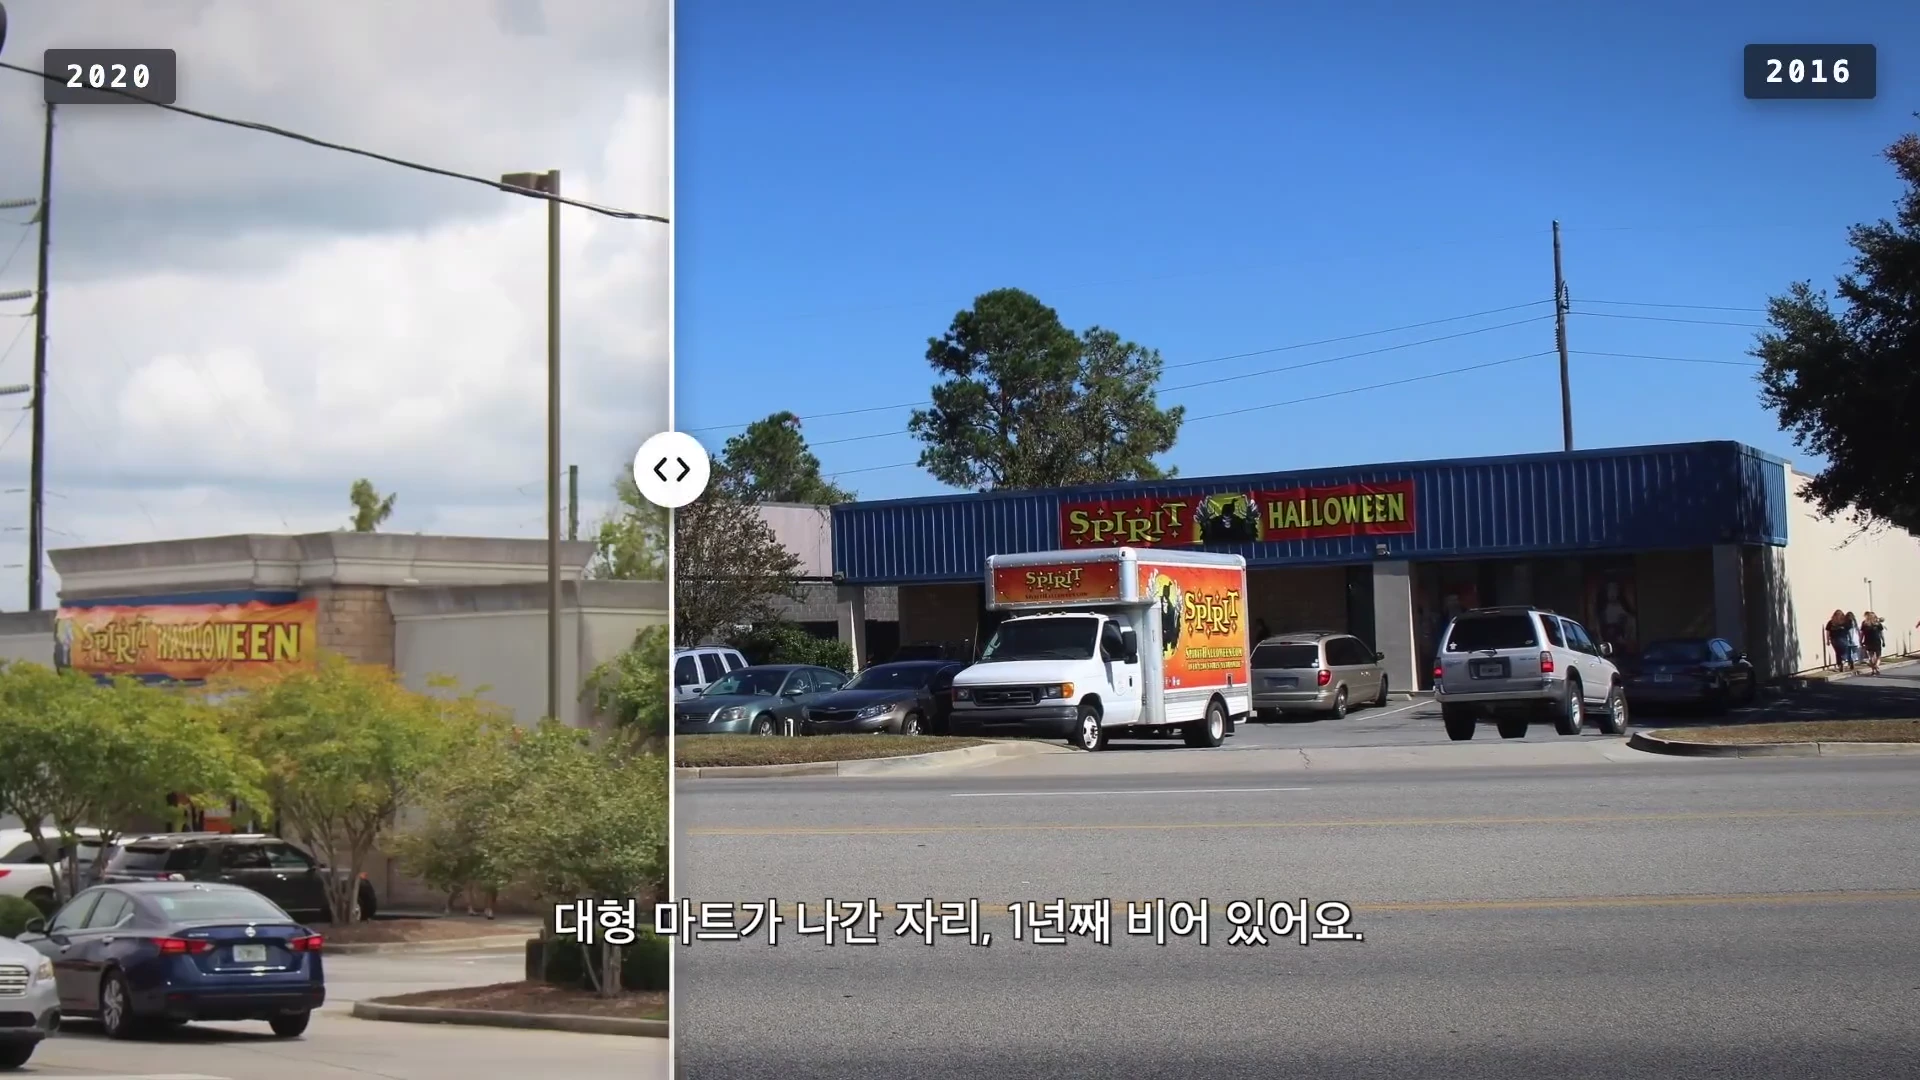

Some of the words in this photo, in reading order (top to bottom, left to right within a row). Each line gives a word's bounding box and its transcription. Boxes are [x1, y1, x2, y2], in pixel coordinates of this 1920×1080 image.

[1069, 502, 1187, 543] SPIRIT
[1268, 492, 1405, 529] HALLOWEEN
[1025, 567, 1083, 589] SPIRIT
[1185, 590, 1239, 634] SPIRIT
[82, 615, 150, 664] SPIRIT
[156, 621, 301, 661] HALLOWEEN
